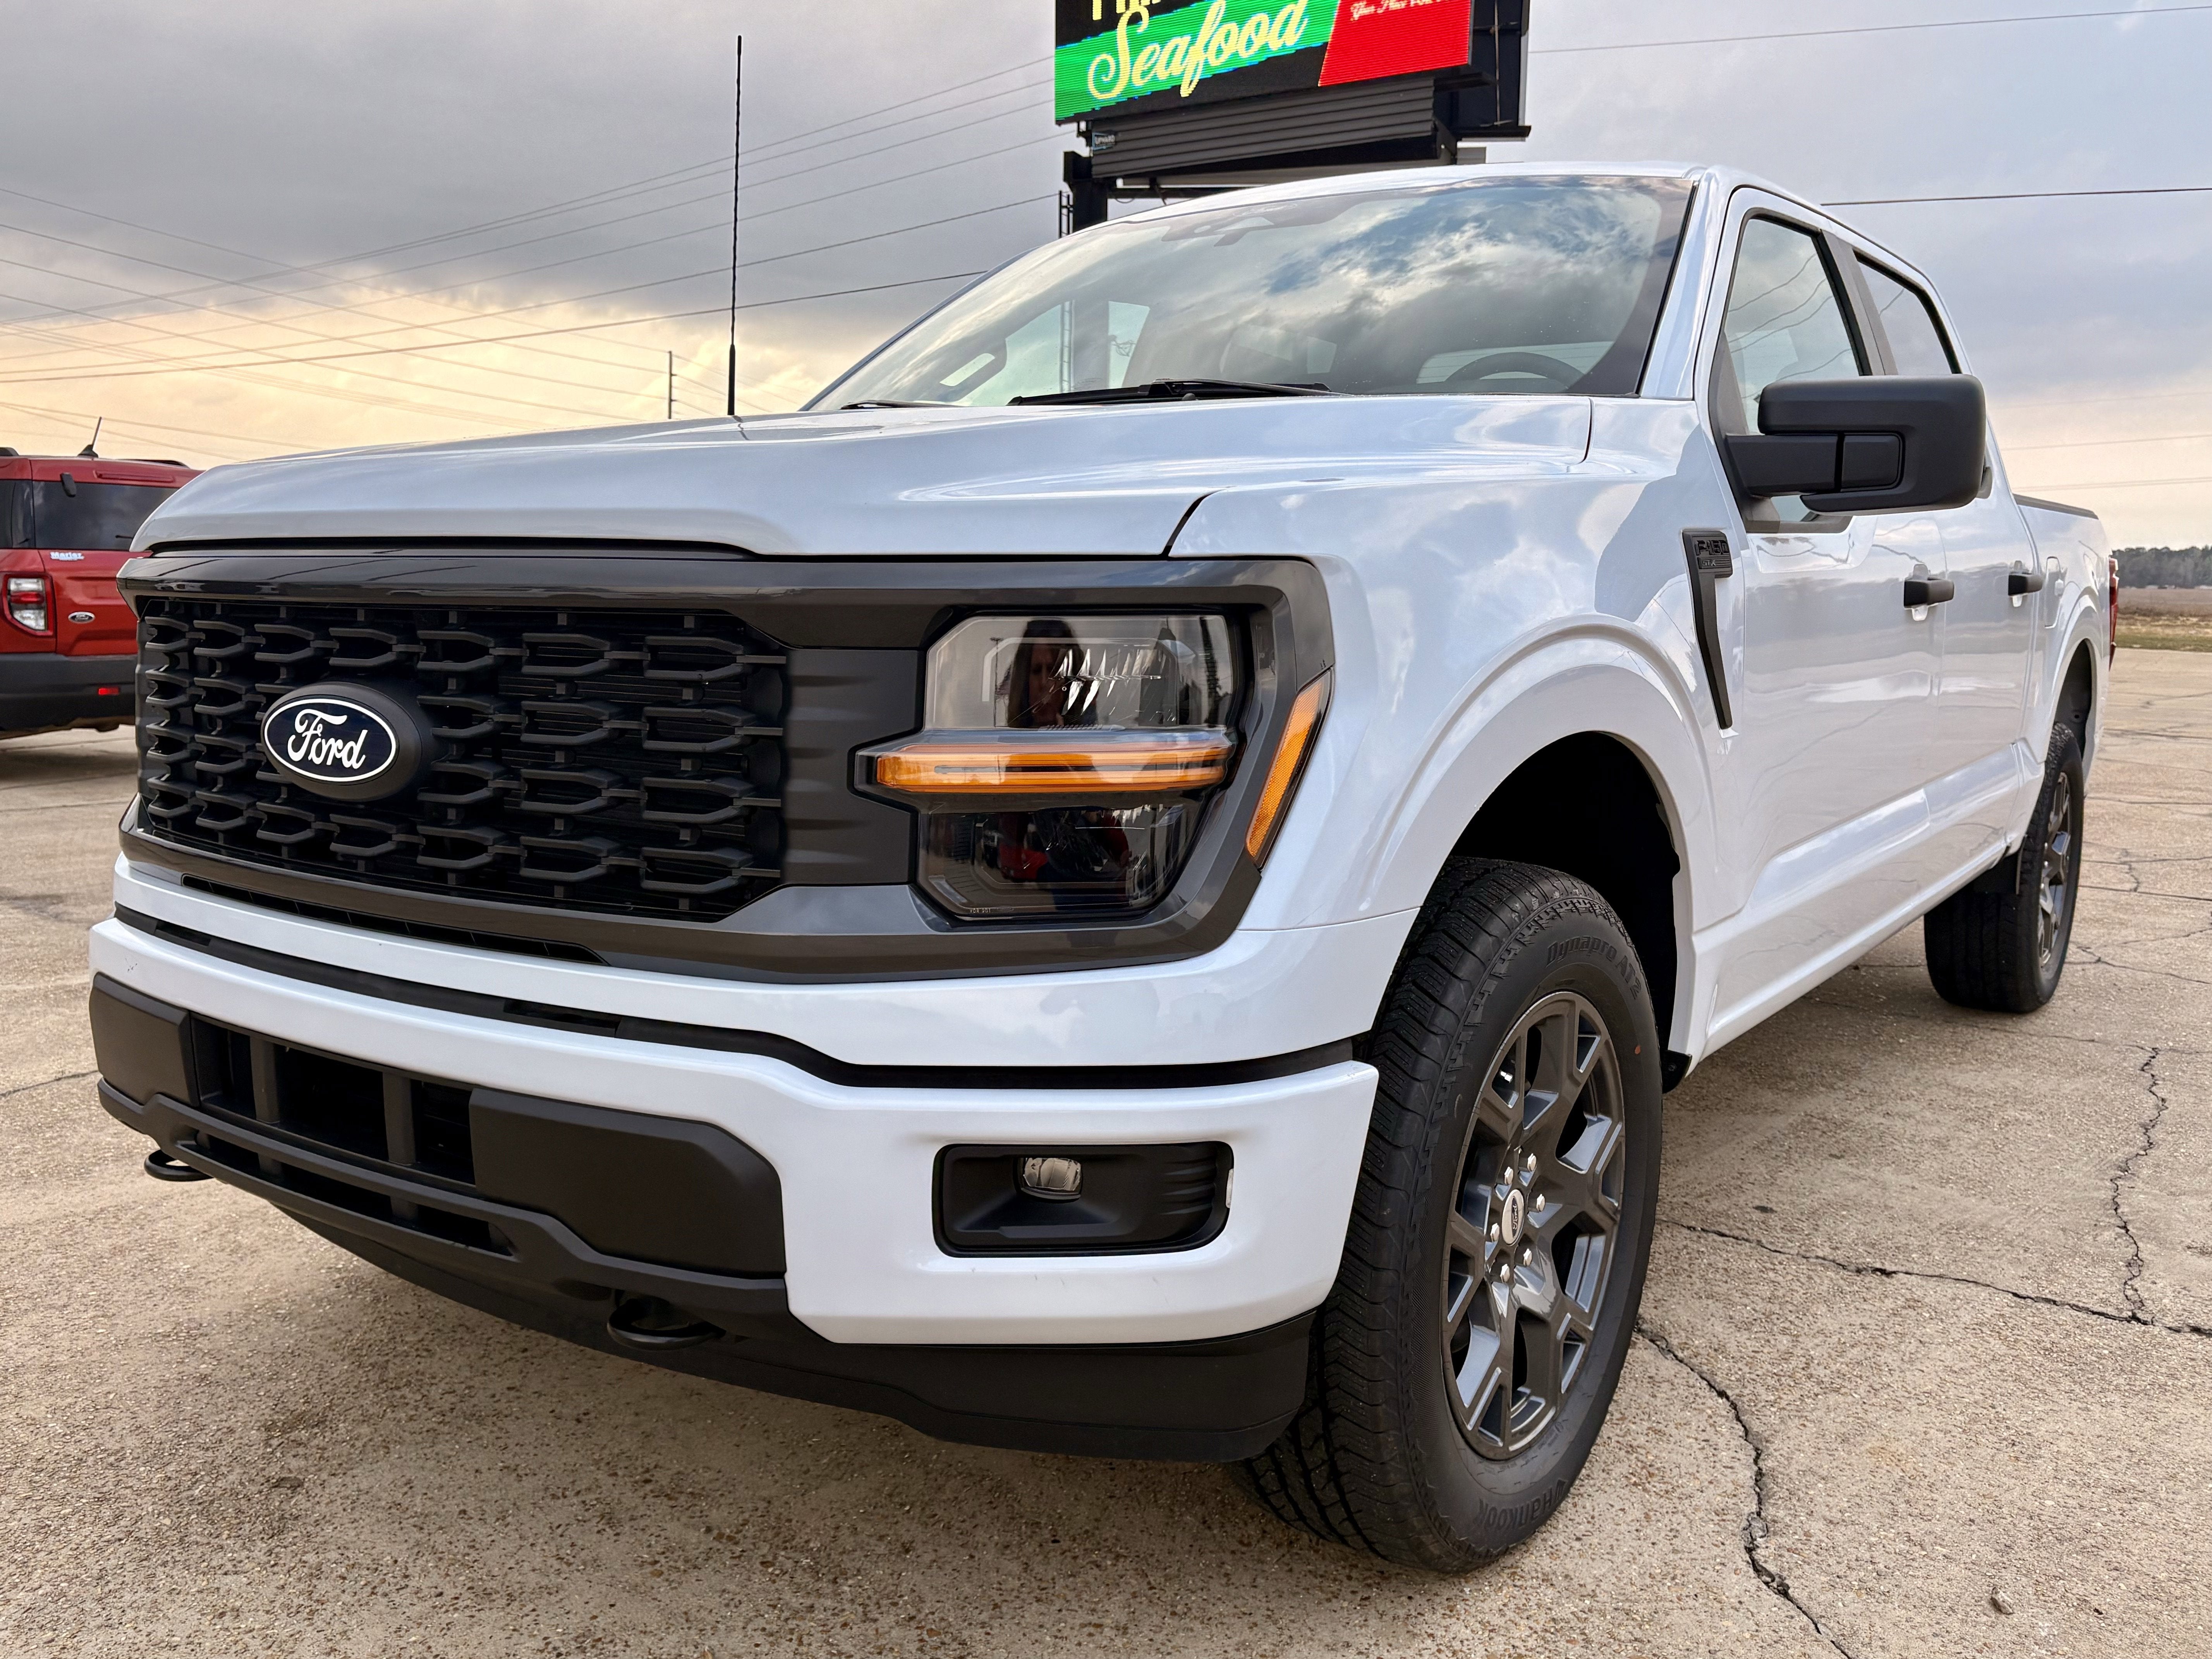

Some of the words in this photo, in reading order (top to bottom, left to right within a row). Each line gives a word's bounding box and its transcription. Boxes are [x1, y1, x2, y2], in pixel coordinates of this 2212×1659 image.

[1087, 0, 1309, 99] Seafood
[1695, 540, 1730, 556] F-150
[287, 709, 368, 769] Ford
[1545, 935, 1617, 968] Dynapro
